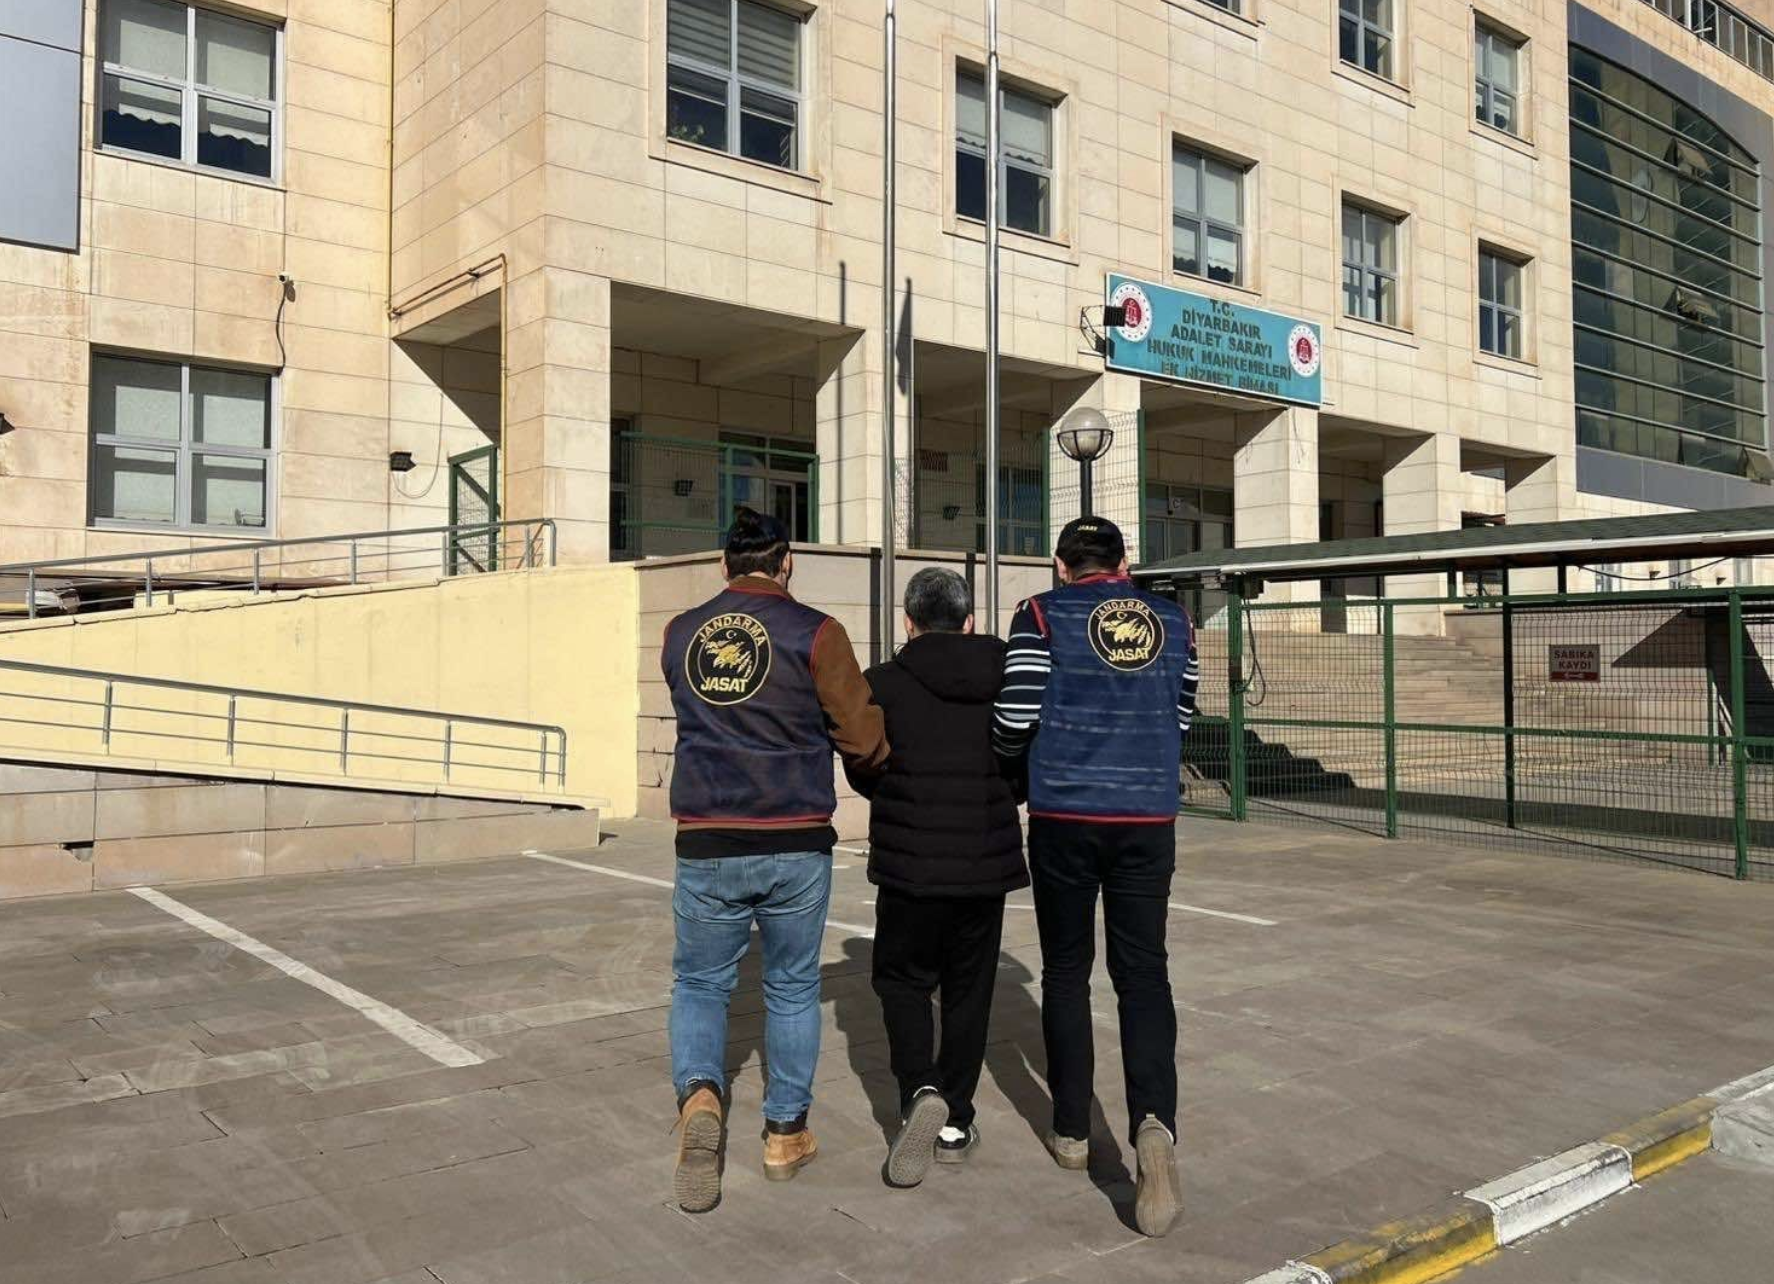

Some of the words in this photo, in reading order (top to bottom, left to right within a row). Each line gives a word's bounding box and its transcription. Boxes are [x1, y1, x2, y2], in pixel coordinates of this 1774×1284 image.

[1210, 299, 1235, 317] T.C.
[1182, 308, 1262, 340] DİYARBAKIR
[1147, 339, 1194, 362] HUKUK
[1171, 324, 1222, 347] ADALET
[1228, 336, 1272, 358] SARAYI
[1095, 600, 1150, 620] JANDARMA
[699, 616, 766, 647] JANDARMA
[1108, 646, 1151, 662] JASAT
[1554, 650, 1594, 659] SABIKA
[1559, 661, 1591, 670] KAYDI
[701, 676, 749, 693] JASAT
